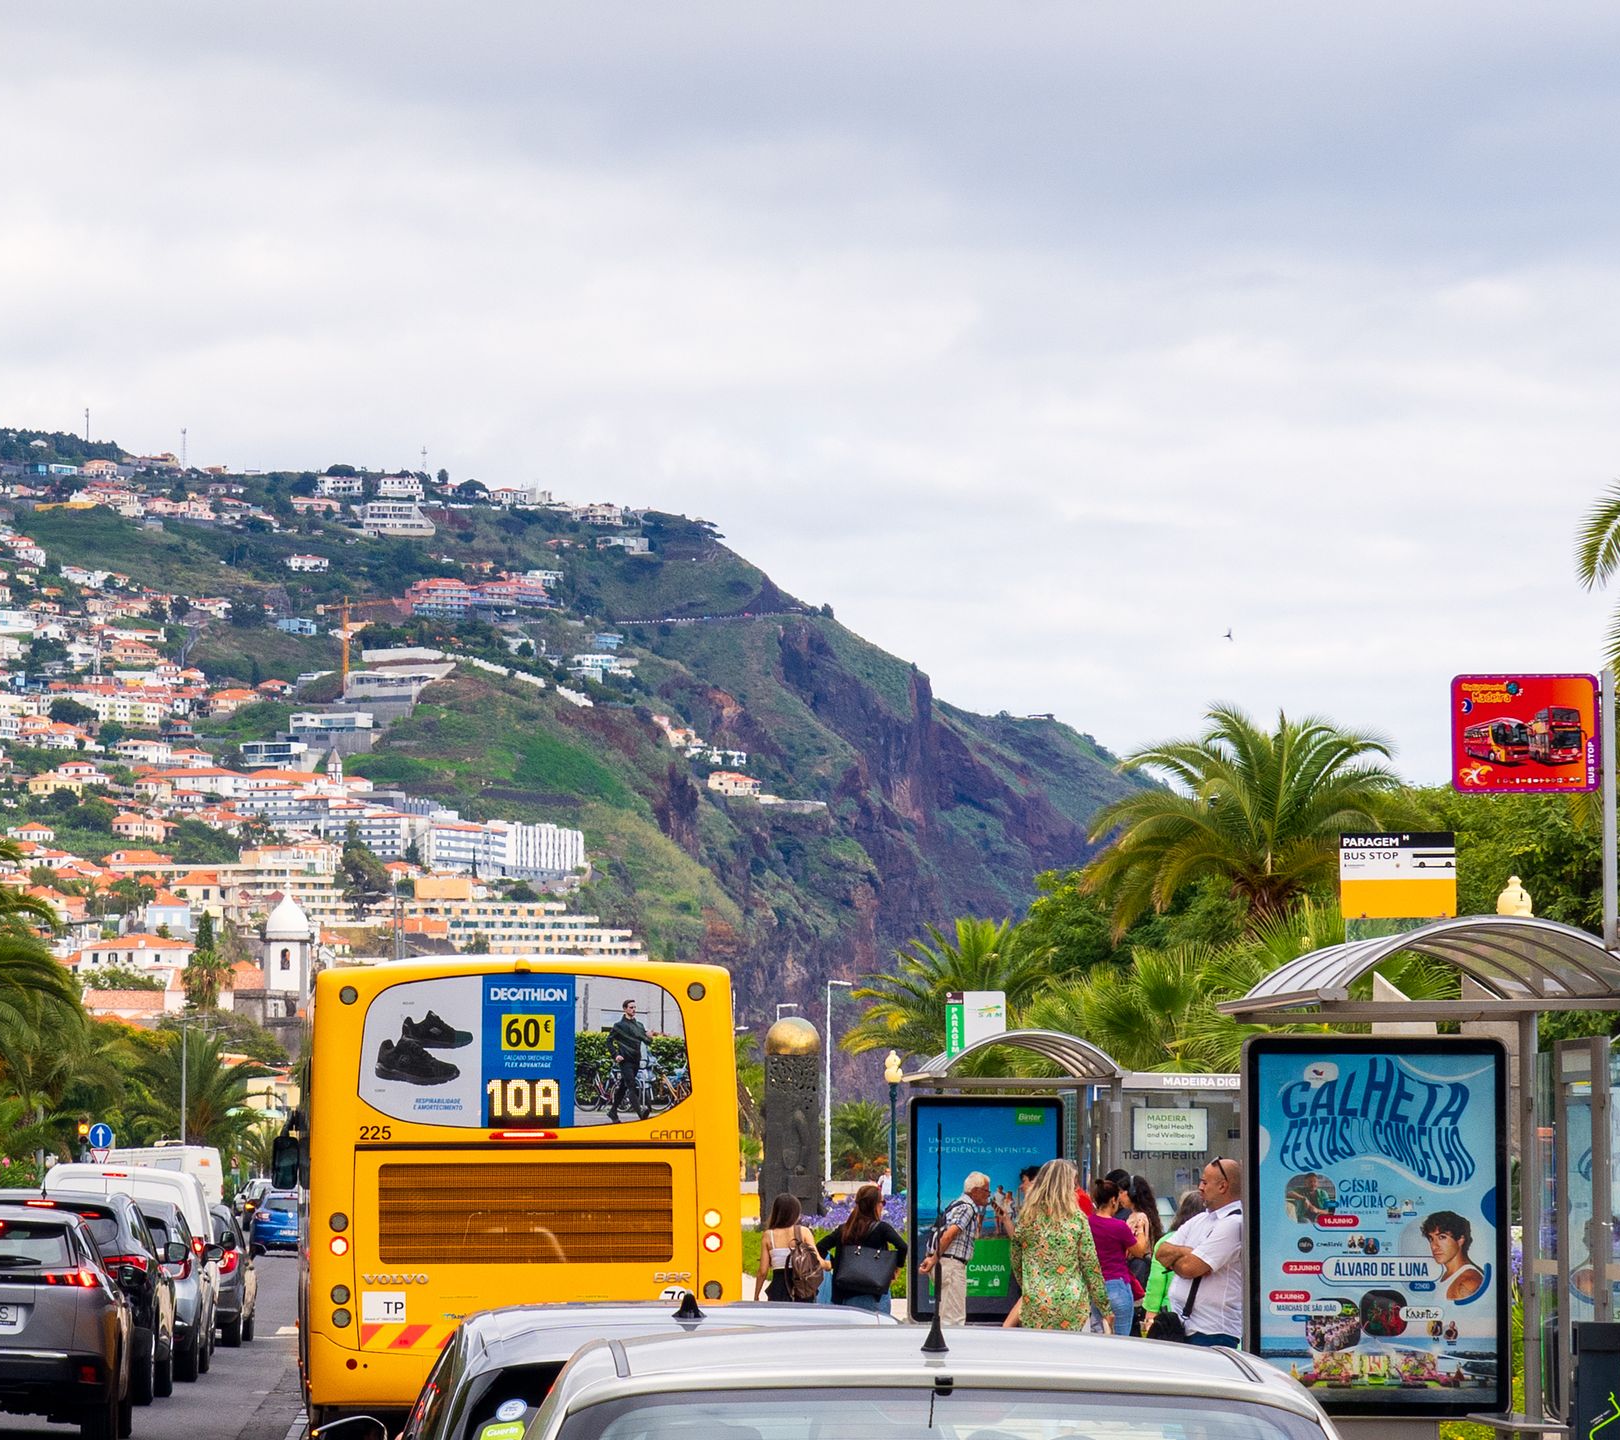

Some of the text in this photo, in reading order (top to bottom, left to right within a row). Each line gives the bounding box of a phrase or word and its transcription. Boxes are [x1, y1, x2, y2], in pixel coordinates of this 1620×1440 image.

[1461, 700, 1468, 712] 2
[1587, 741, 1595, 785] BUS STOP
[1342, 837, 1399, 847] PARAGEM
[1344, 851, 1399, 860] BUS STOP
[489, 987, 568, 1002] DECATHLON
[951, 1007, 959, 1053] PARAGEM
[1162, 1076, 1215, 1086] MADEIRA
[487, 1079, 559, 1116] 10A
[1281, 1056, 1470, 1127] CALHETA
[1018, 1113, 1042, 1121] Binter
[359, 1126, 391, 1140] 225
[1147, 1123, 1170, 1131] Digital
[650, 1129, 694, 1140] CAMO
[1279, 1116, 1357, 1173] FESTAS
[1373, 1118, 1476, 1186] CONCELHO
[1338, 1179, 1378, 1193] CÉSAR
[1339, 1193, 1397, 1208] MOURÃO
[968, 1264, 1006, 1272] CANARIA
[1334, 1260, 1428, 1277] ÁLVARO DE LUNA
[362, 1273, 429, 1285] VOLVO
[383, 1302, 404, 1314] TP
[1312, 1303, 1323, 1311] SÃO
[1323, 1303, 1336, 1312] JOÃO
